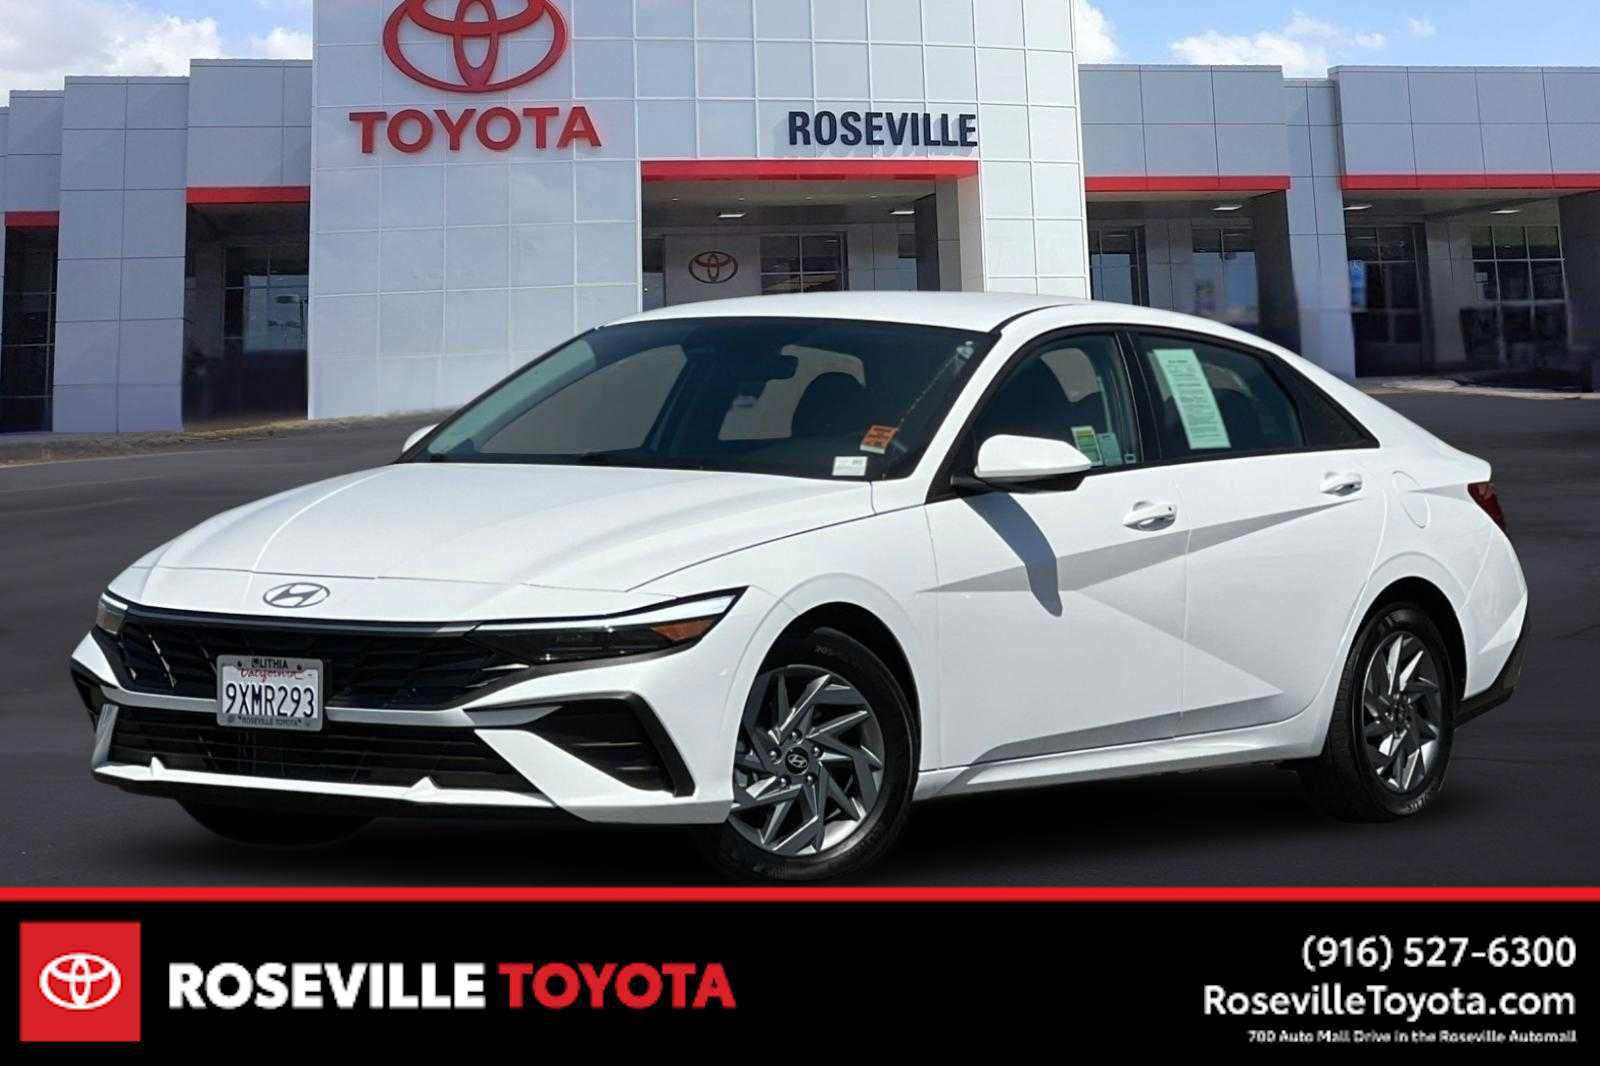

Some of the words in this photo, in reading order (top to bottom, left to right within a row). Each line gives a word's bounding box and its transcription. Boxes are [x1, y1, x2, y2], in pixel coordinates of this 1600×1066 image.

[349, 106, 602, 153] TOYOTA
[787, 110, 978, 147] ROSEVILLE
[225, 683, 314, 718] 9XMR293
